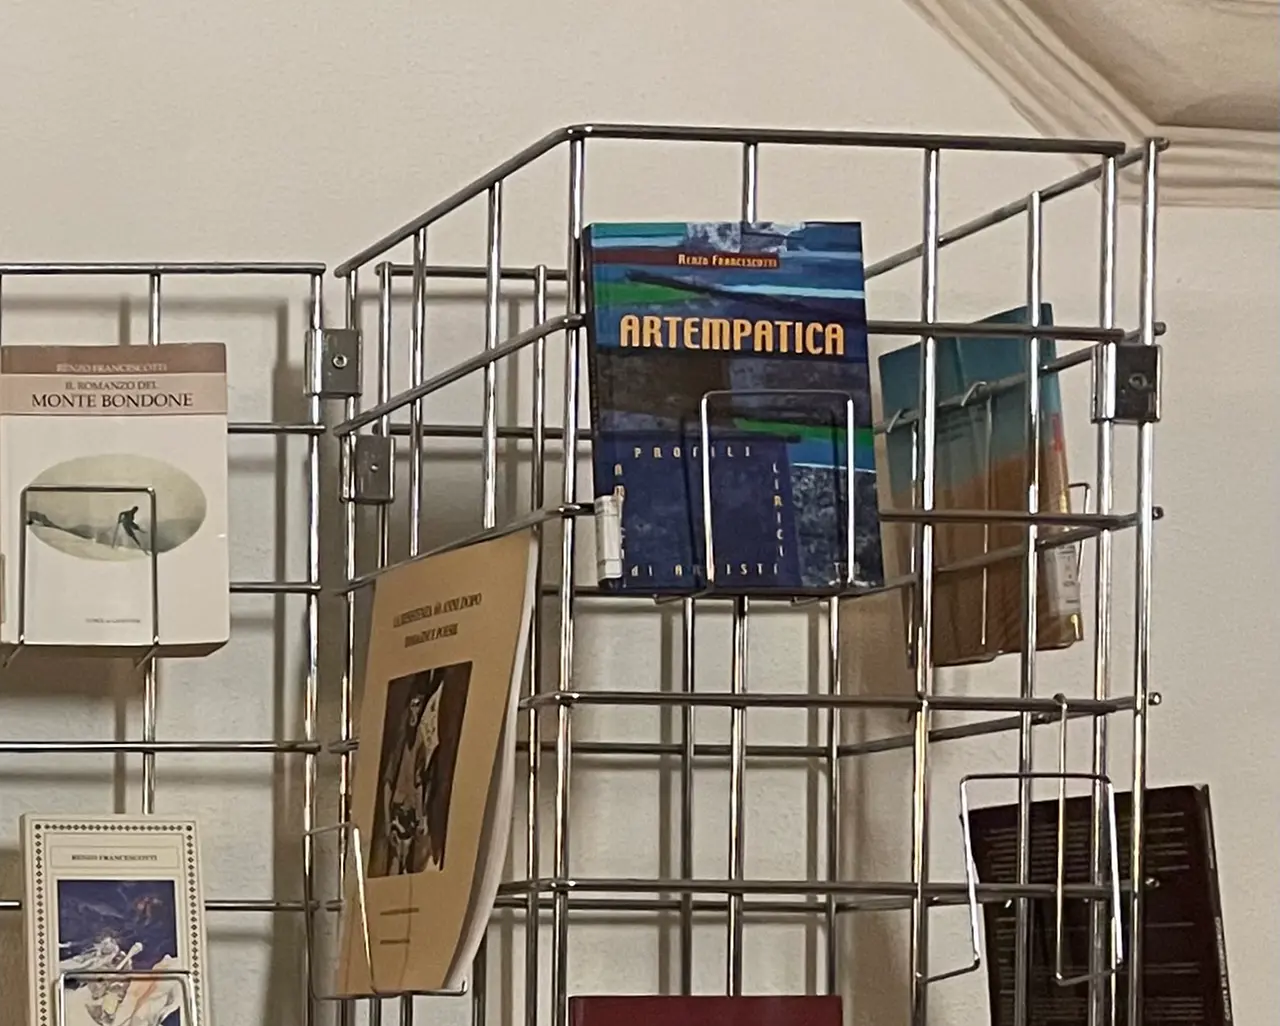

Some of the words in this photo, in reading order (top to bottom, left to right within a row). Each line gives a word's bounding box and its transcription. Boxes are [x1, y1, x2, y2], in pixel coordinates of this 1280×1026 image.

[620, 314, 845, 356] ARTEMPATICA
[65, 381, 74, 390] IL
[77, 381, 135, 390] ROMANZO
[138, 380, 158, 390] DEL
[32, 394, 97, 408] MONTE
[102, 392, 194, 408] BONDONE
